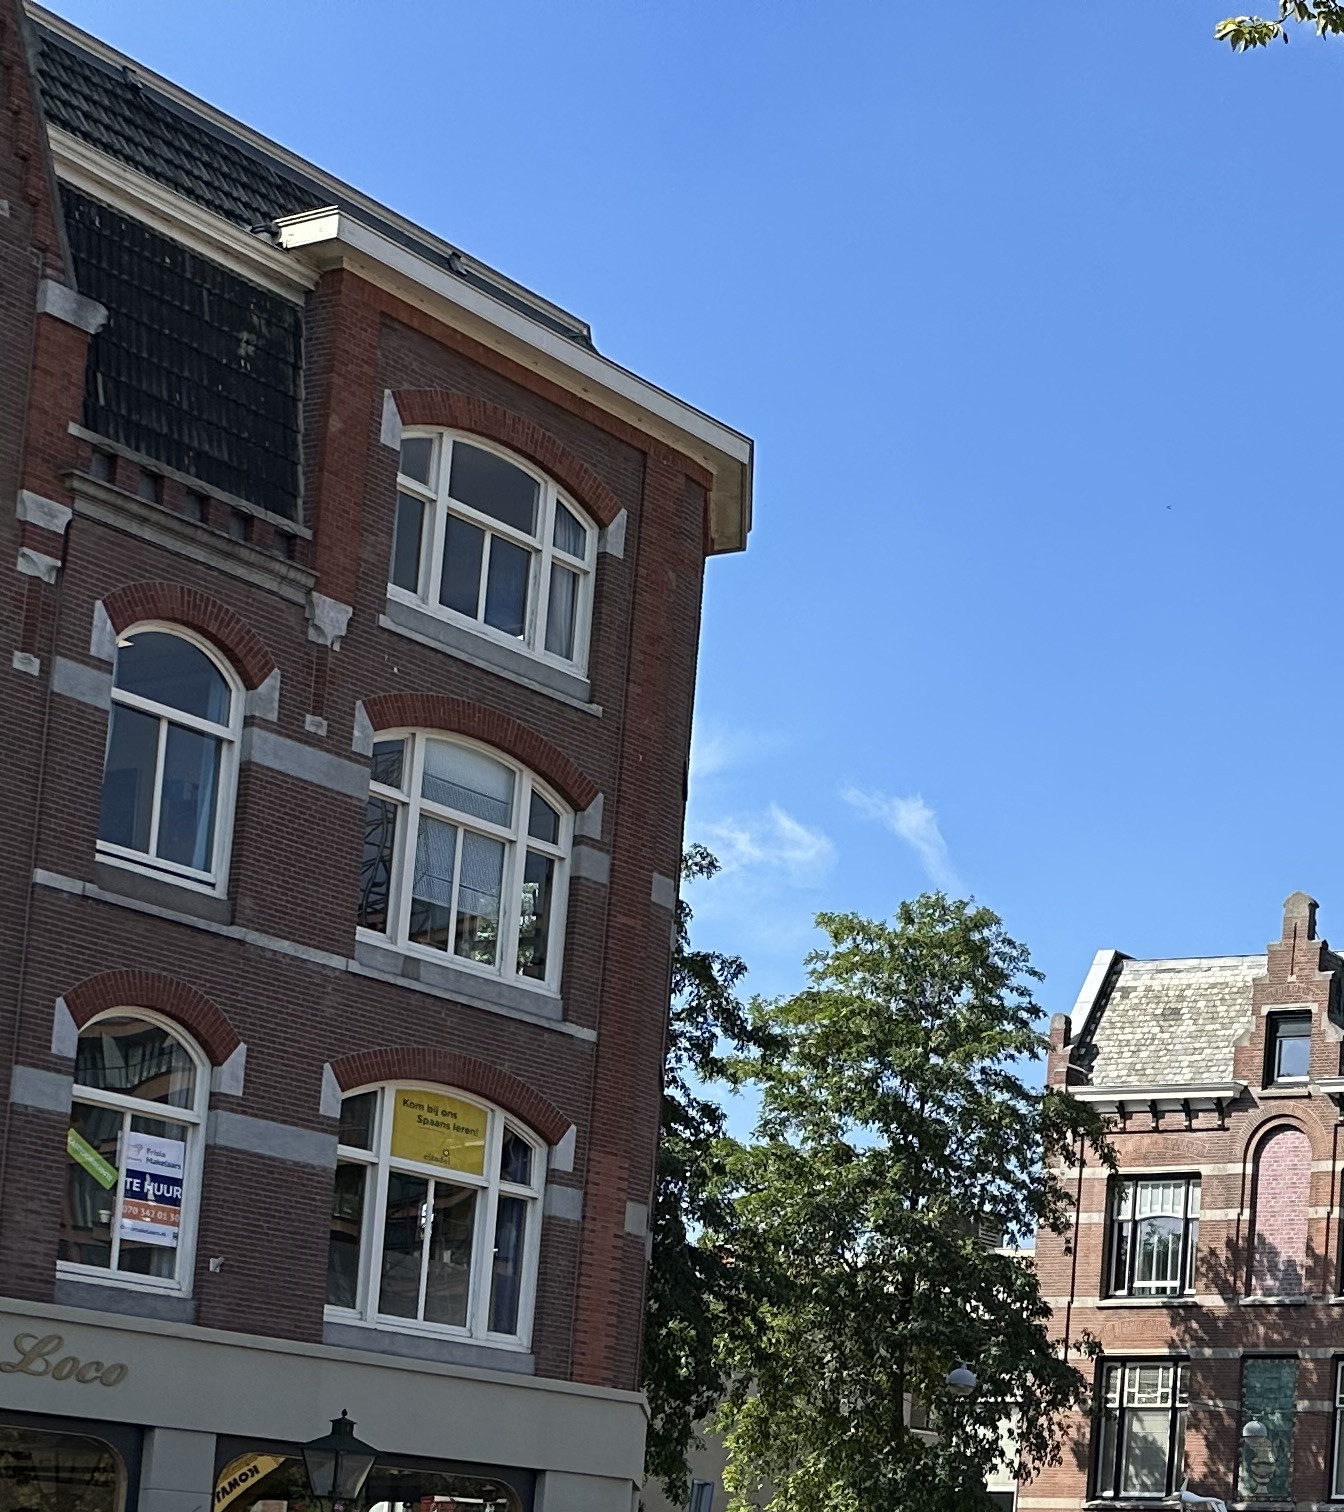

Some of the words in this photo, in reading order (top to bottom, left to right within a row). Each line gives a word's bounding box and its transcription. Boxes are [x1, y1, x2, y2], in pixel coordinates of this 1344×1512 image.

[402, 1098, 425, 1112] Kom
[427, 1104, 440, 1117] bij
[441, 1109, 458, 1120] ons
[416, 1114, 451, 1131] Spaans
[453, 1123, 479, 1137] leren!
[145, 1156, 182, 1171] Makelaars
[146, 1147, 167, 1159] Frisia
[125, 1177, 142, 1192] TE
[143, 1182, 182, 1199] HUUR
[0, 1332, 129, 1387] Loco
